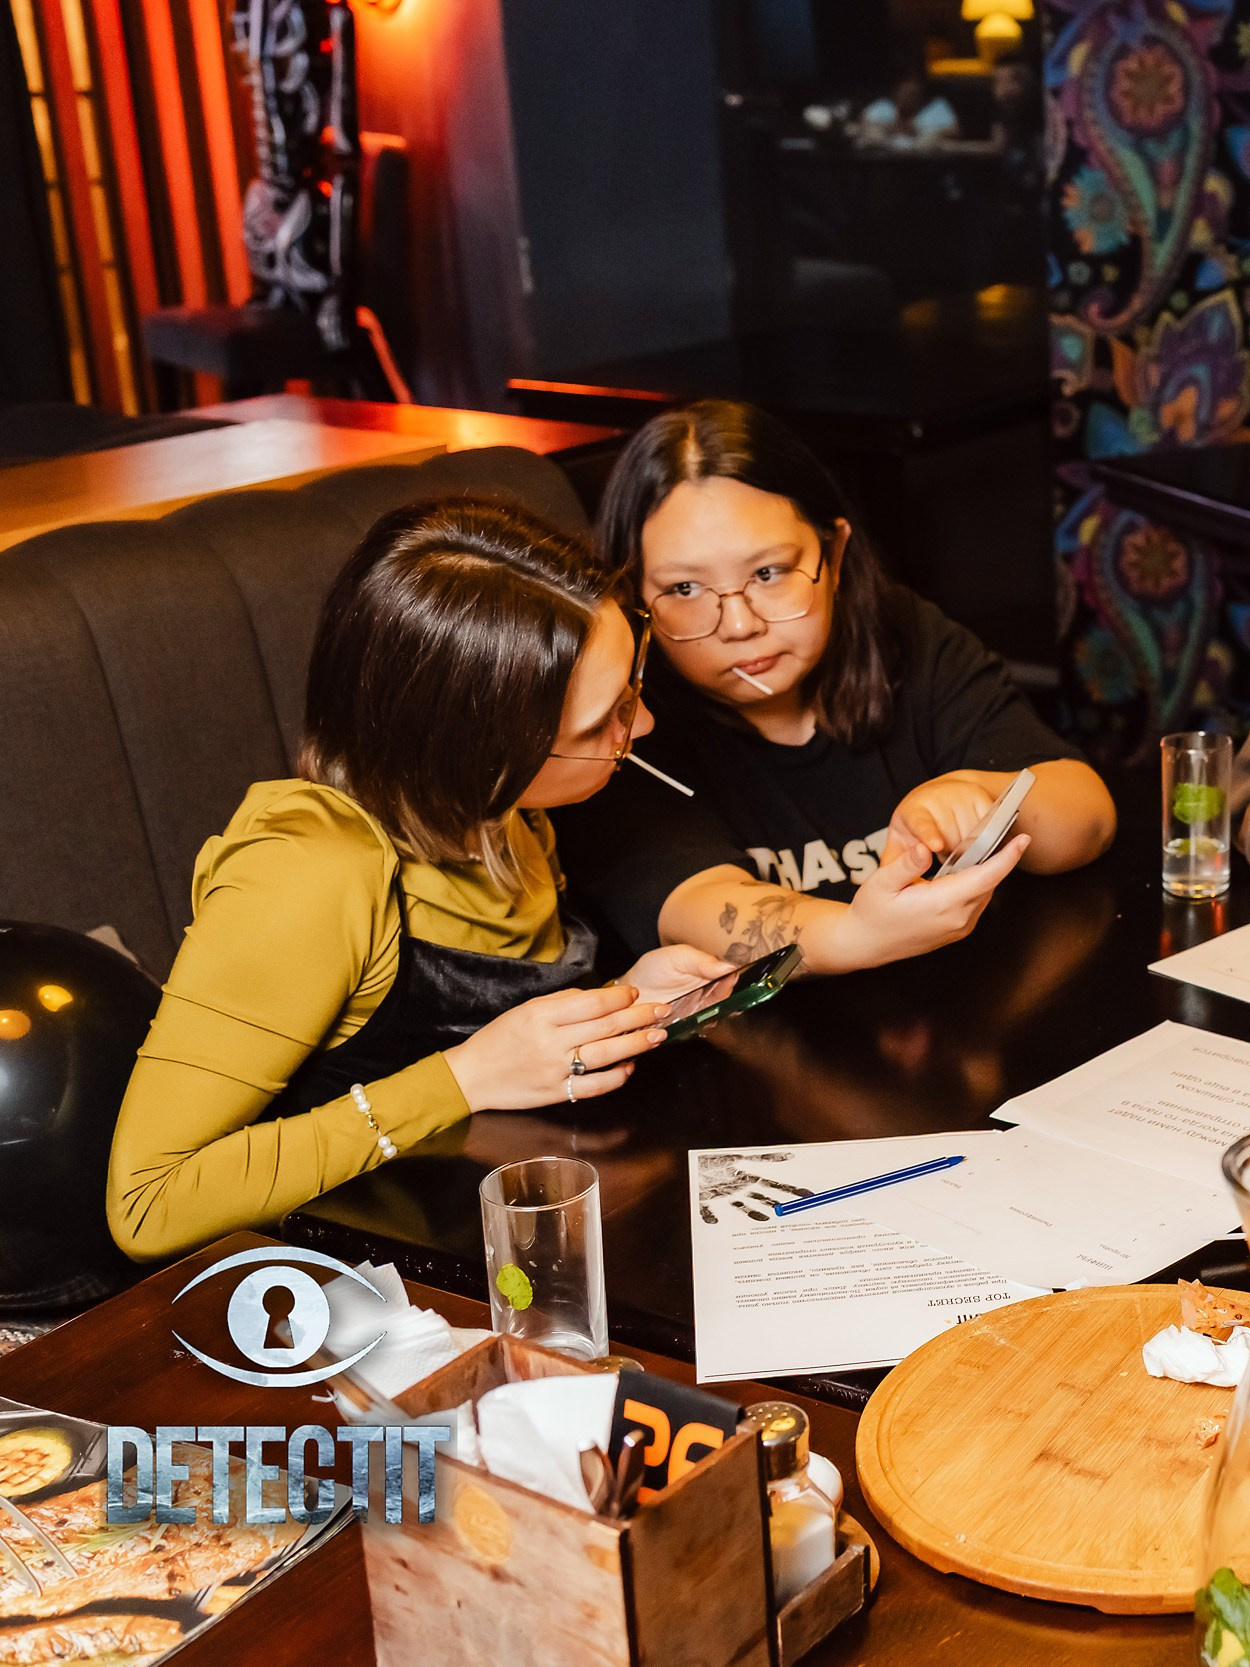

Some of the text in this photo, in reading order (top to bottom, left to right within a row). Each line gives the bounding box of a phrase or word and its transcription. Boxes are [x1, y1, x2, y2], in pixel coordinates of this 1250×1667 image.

[1148, 1120, 1182, 1133] нами
[1182, 1130, 1228, 1147] между
[927, 1292, 1010, 1306] TOP SECRET
